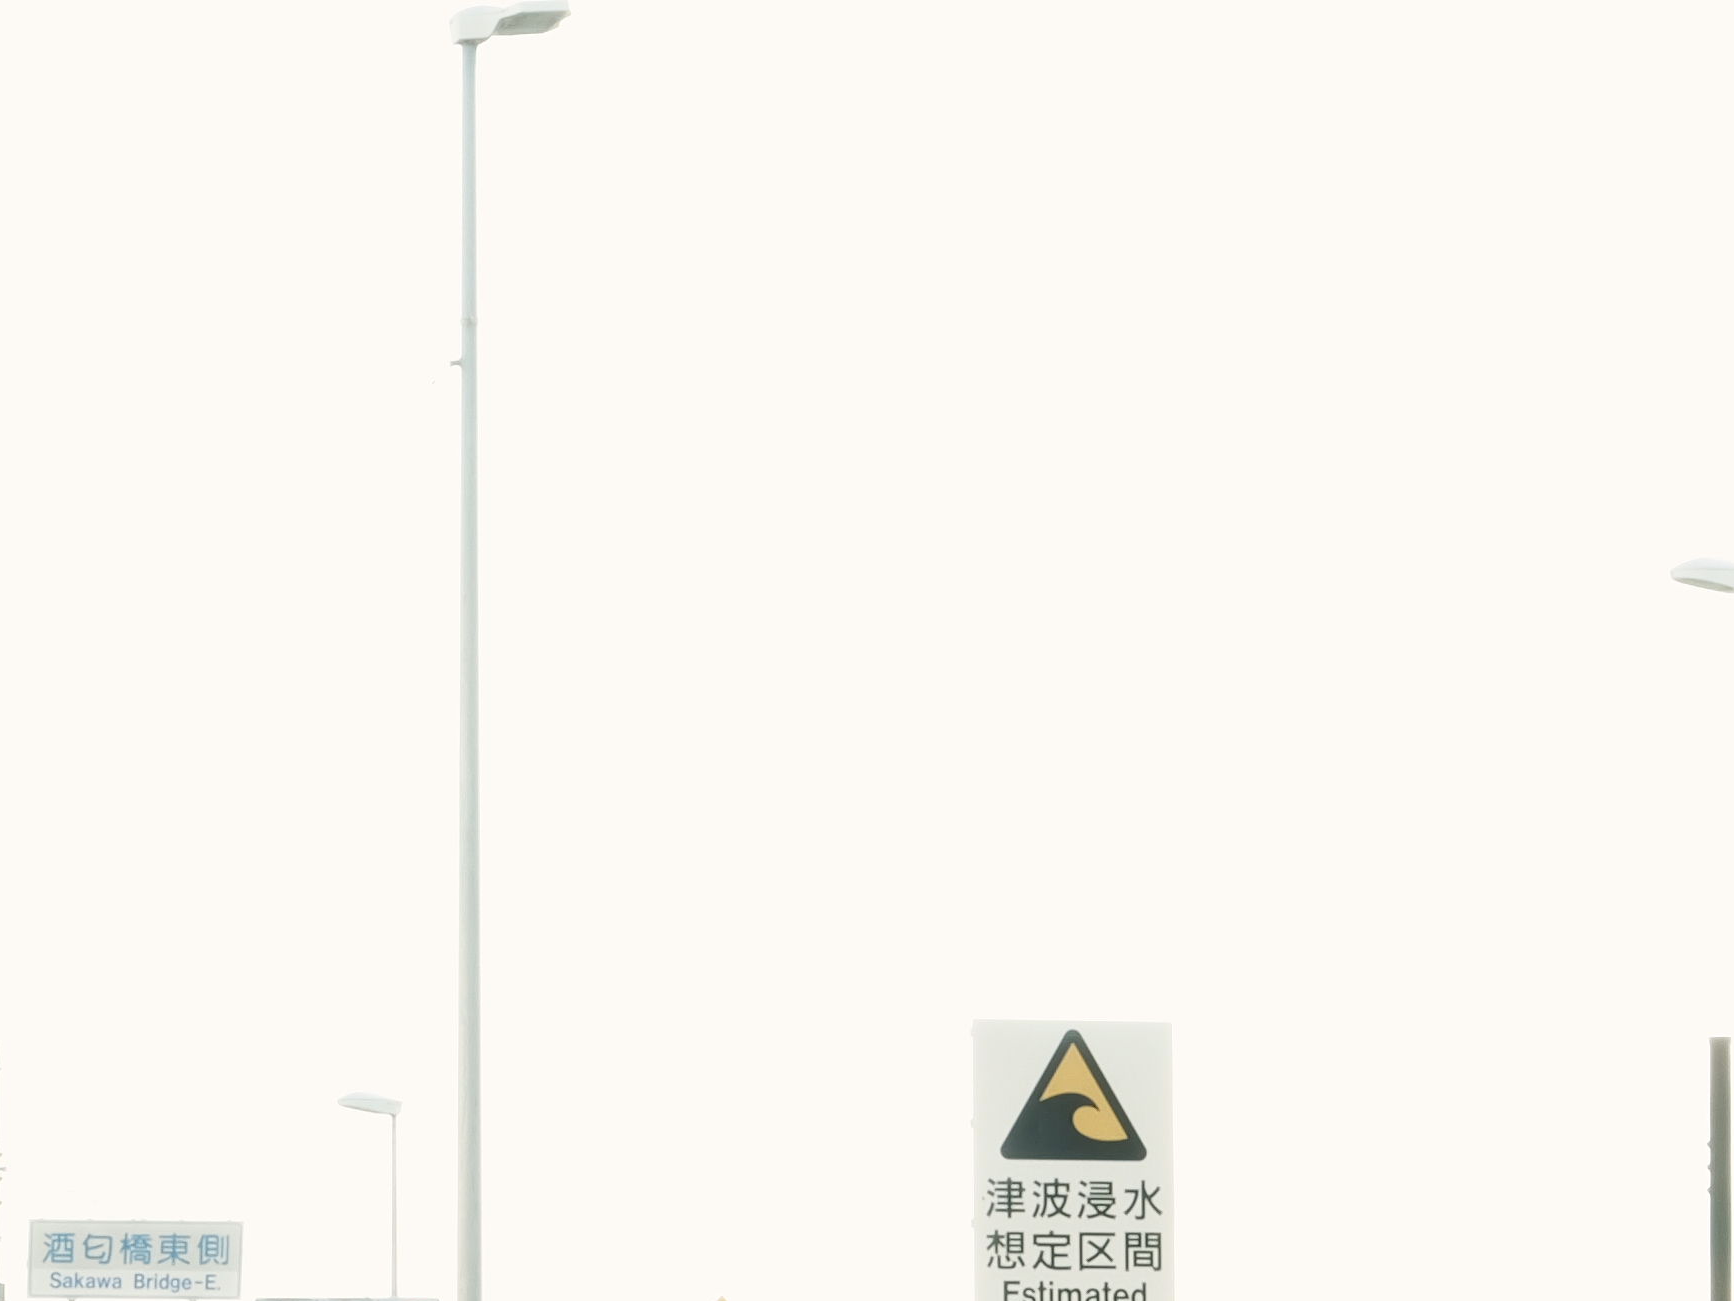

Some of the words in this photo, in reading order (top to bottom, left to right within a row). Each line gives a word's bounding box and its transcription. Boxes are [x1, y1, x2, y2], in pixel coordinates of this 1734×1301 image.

[984, 1178, 1164, 1220] 津波浸水
[42, 1233, 230, 1266] 酒匂橋東側
[985, 1231, 1163, 1272] 想定区間
[49, 1272, 122, 1290] Sakawa
[133, 1273, 222, 1293] Bridge-E.
